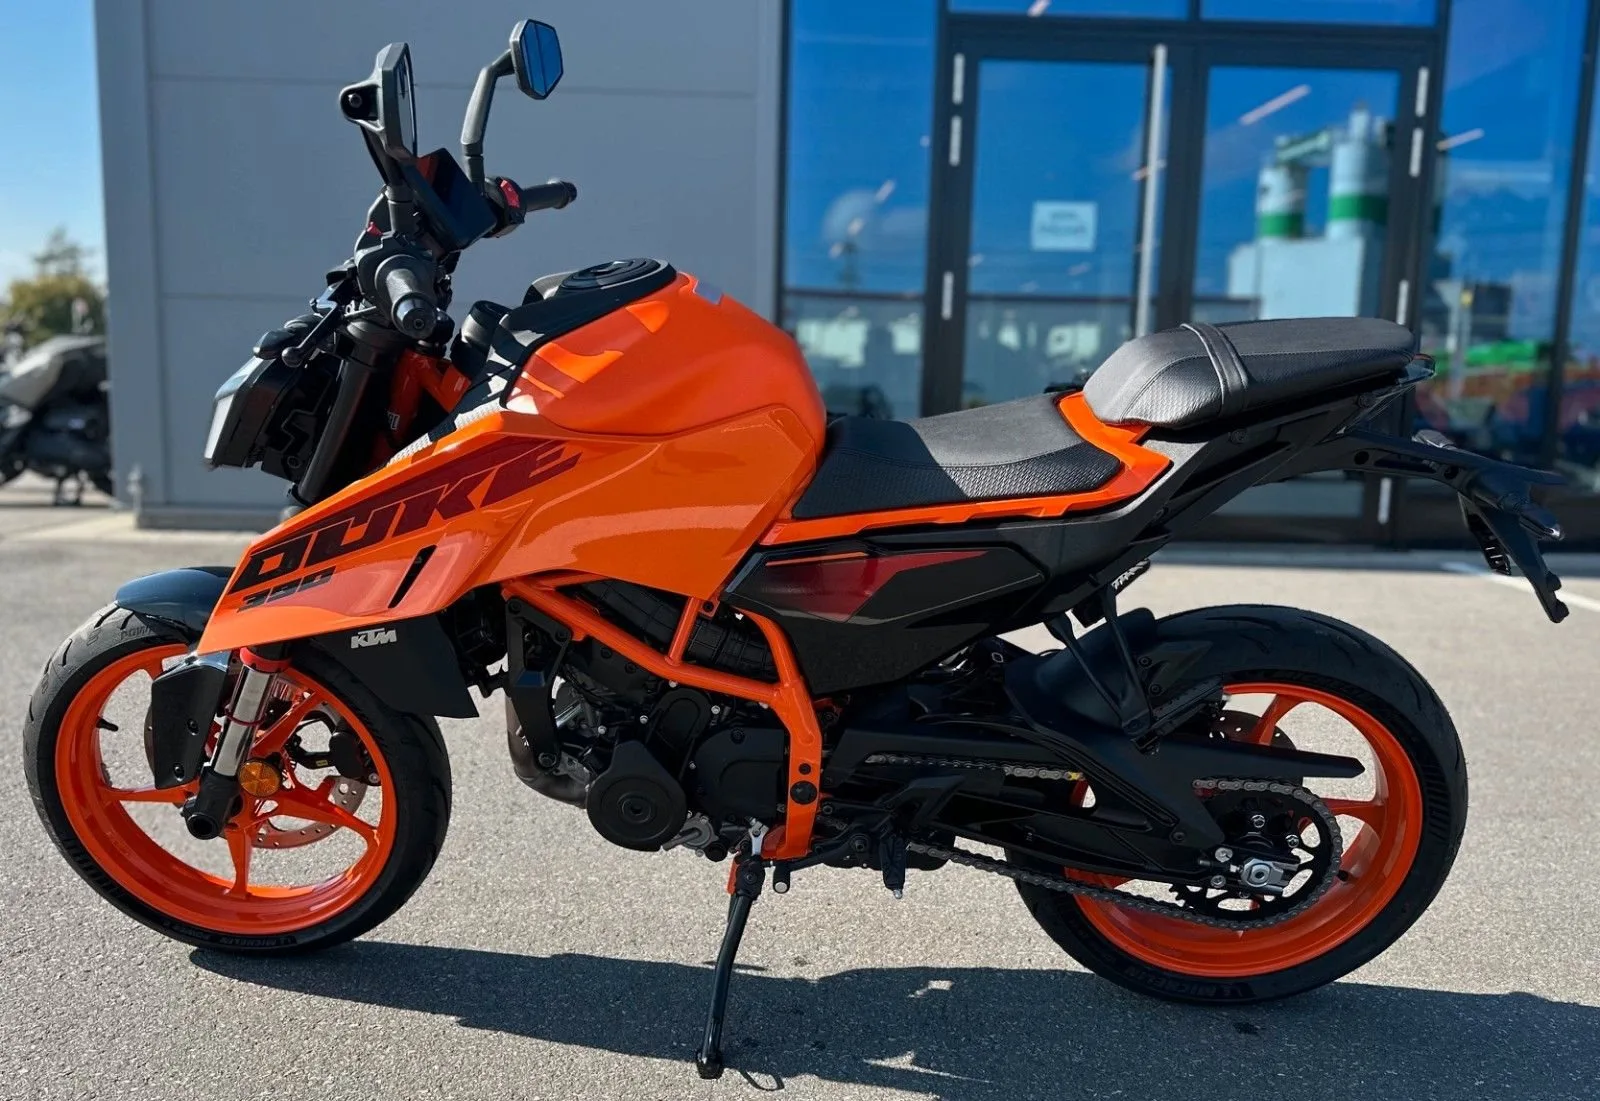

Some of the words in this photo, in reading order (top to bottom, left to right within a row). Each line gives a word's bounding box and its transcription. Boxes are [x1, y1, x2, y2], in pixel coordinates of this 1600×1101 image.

[228, 439, 582, 595] DUKE
[237, 565, 336, 613] 390
[351, 627, 397, 649] KTM
